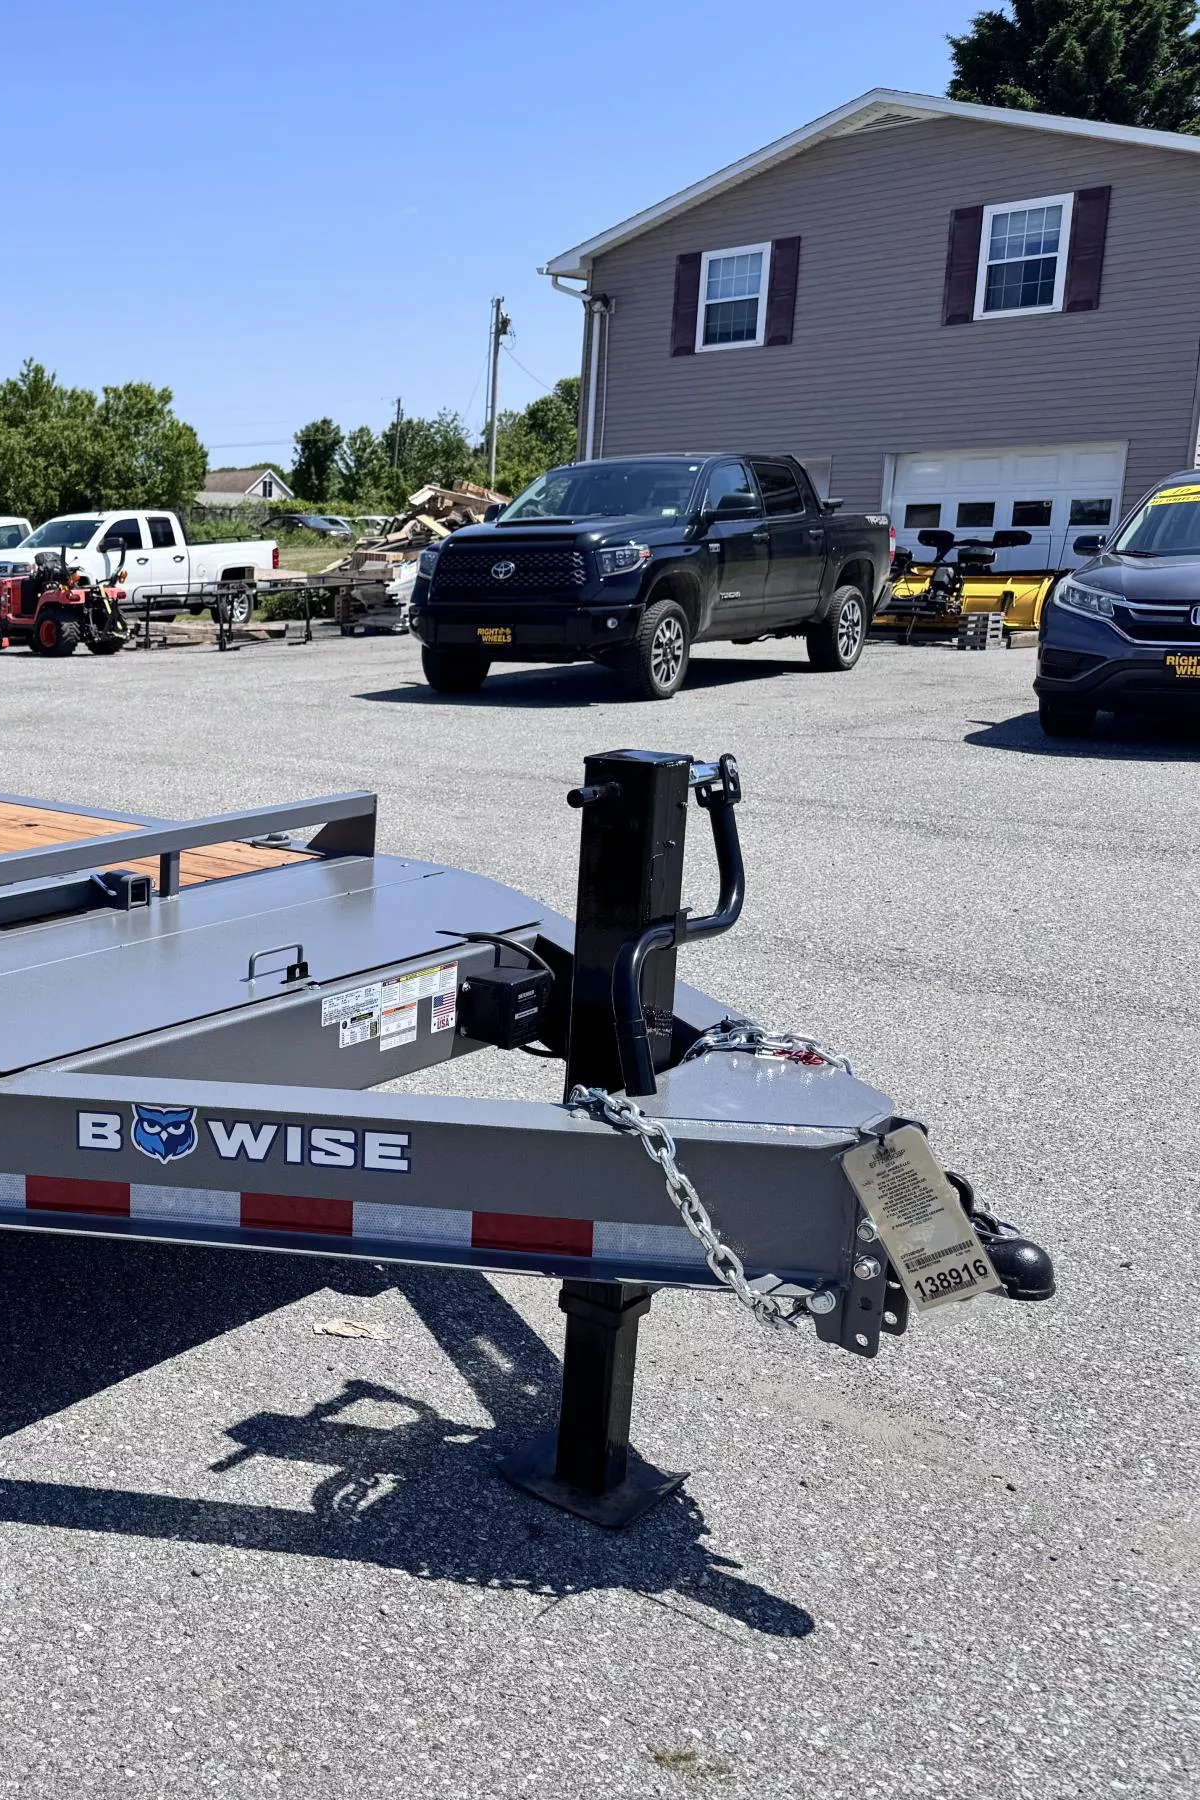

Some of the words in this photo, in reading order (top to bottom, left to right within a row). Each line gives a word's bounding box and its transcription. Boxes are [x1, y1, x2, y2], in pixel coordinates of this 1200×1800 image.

[476, 627, 499, 636] RIGHT
[481, 634, 512, 643] WHEELS
[436, 1016, 451, 1030] USA
[914, 1258, 988, 1298] 138916
